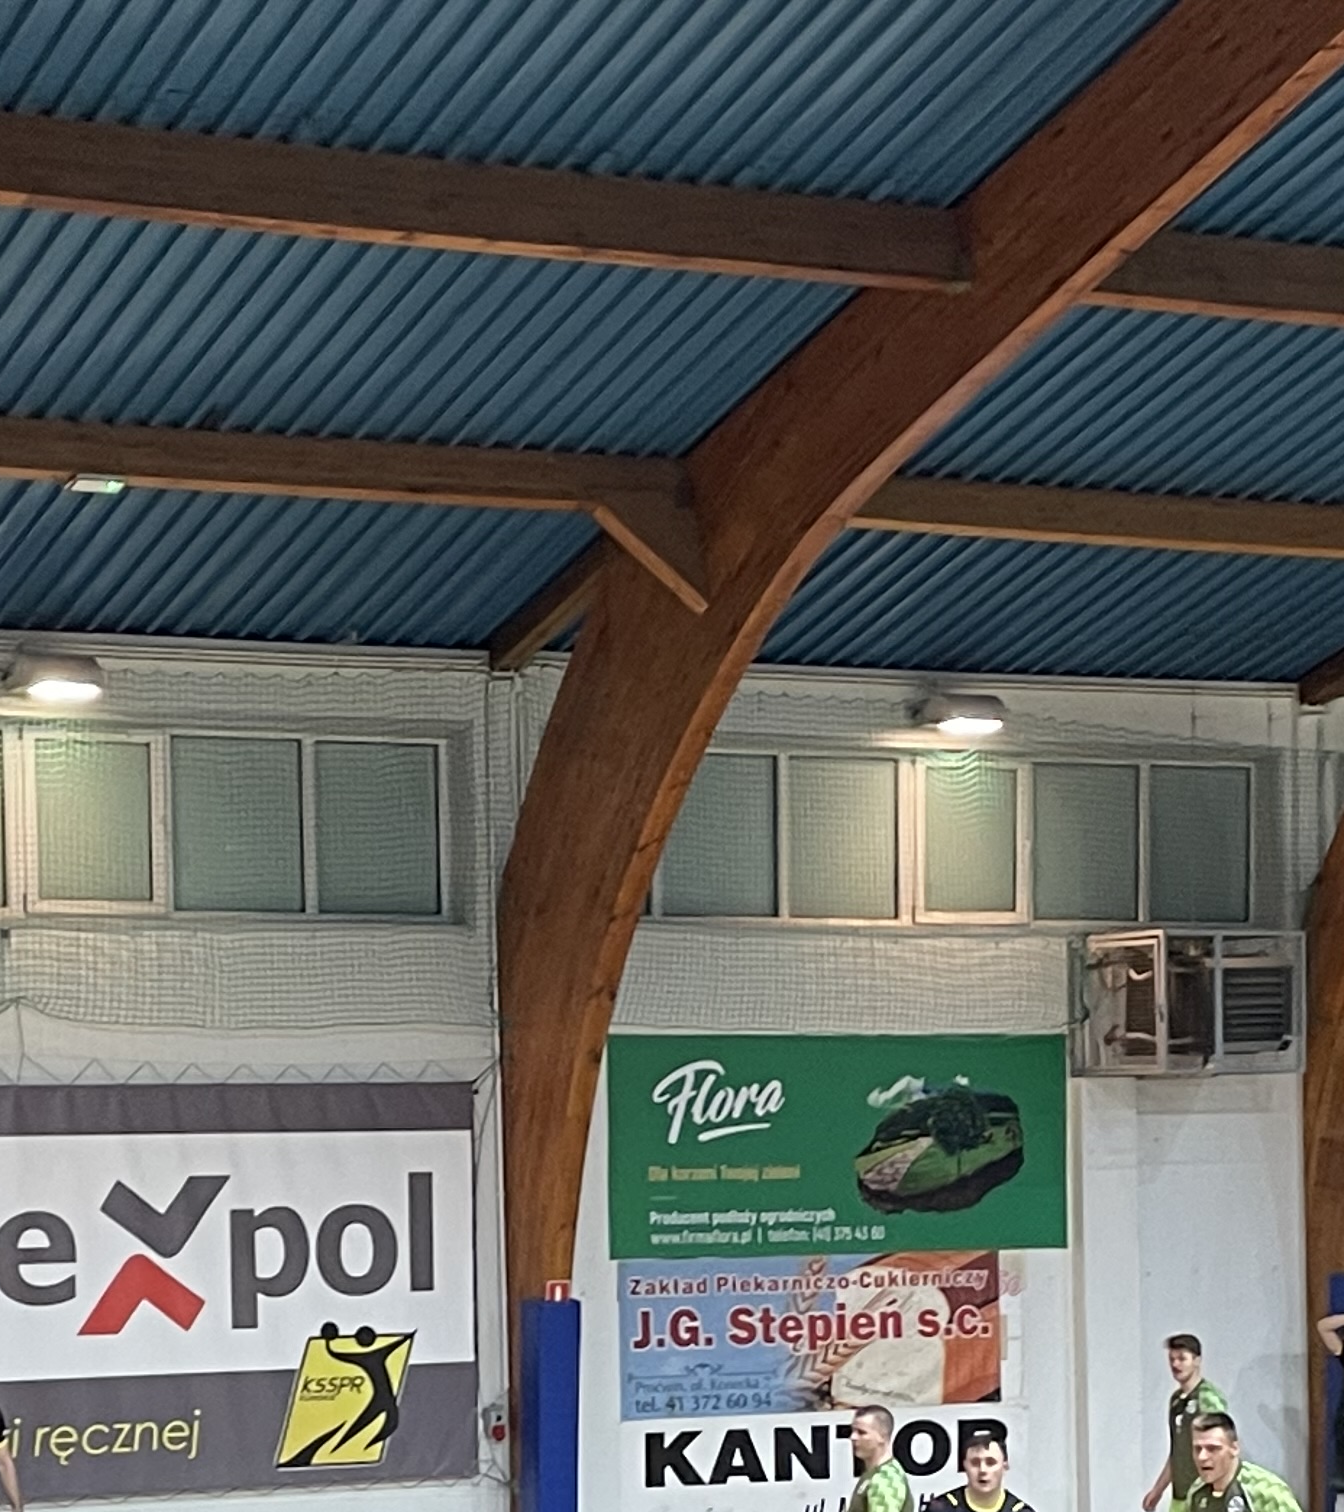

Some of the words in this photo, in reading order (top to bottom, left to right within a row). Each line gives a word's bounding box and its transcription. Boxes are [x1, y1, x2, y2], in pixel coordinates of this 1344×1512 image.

[653, 1059, 785, 1144] Flora
[632, 1309, 714, 1350] J.G.
[728, 1298, 903, 1352] Stępień
[917, 1306, 990, 1339] s.c.
[300, 1375, 366, 1396] KSSPR
[690, 1394, 721, 1411] 372
[725, 1393, 748, 1409] 60
[33, 1410, 202, 1465] ręcznej
